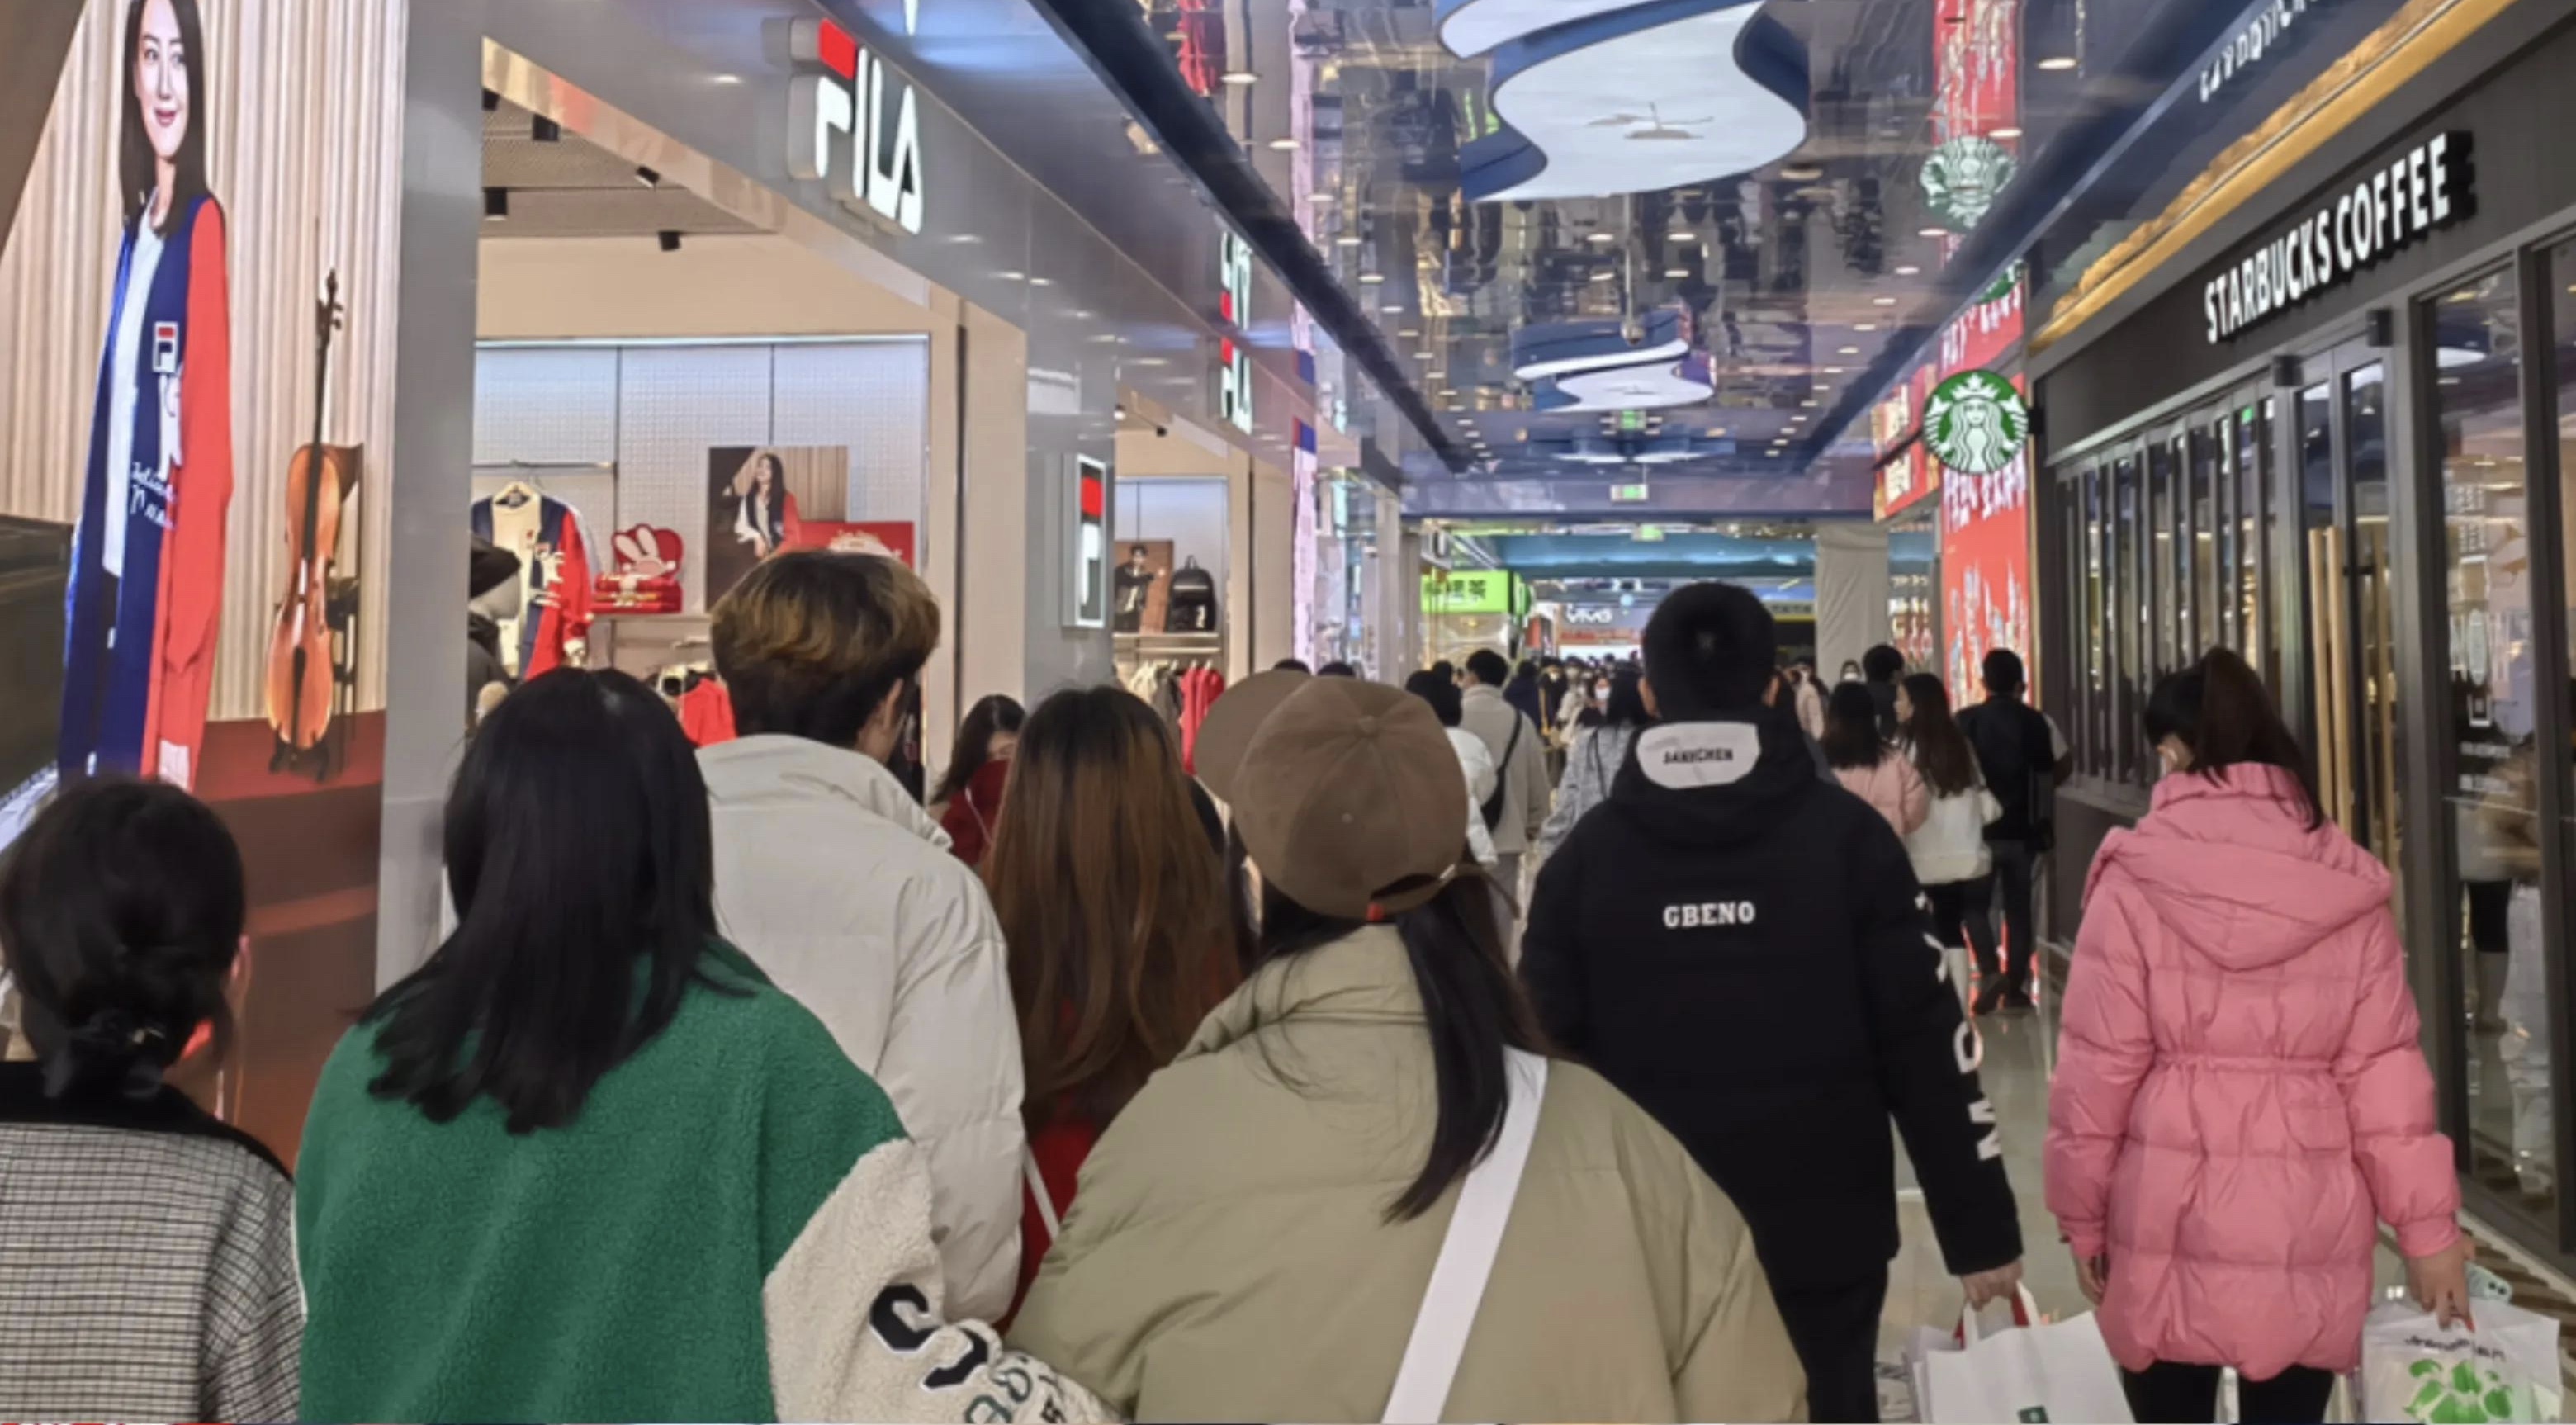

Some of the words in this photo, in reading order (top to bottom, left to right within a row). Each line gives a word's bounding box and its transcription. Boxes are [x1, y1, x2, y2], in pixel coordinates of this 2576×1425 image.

[815, 17, 923, 234] FILA
[2204, 209, 2332, 344] STARBUCKS
[2337, 133, 2450, 271] COFFEE
[1663, 900, 1756, 929] GBENO
